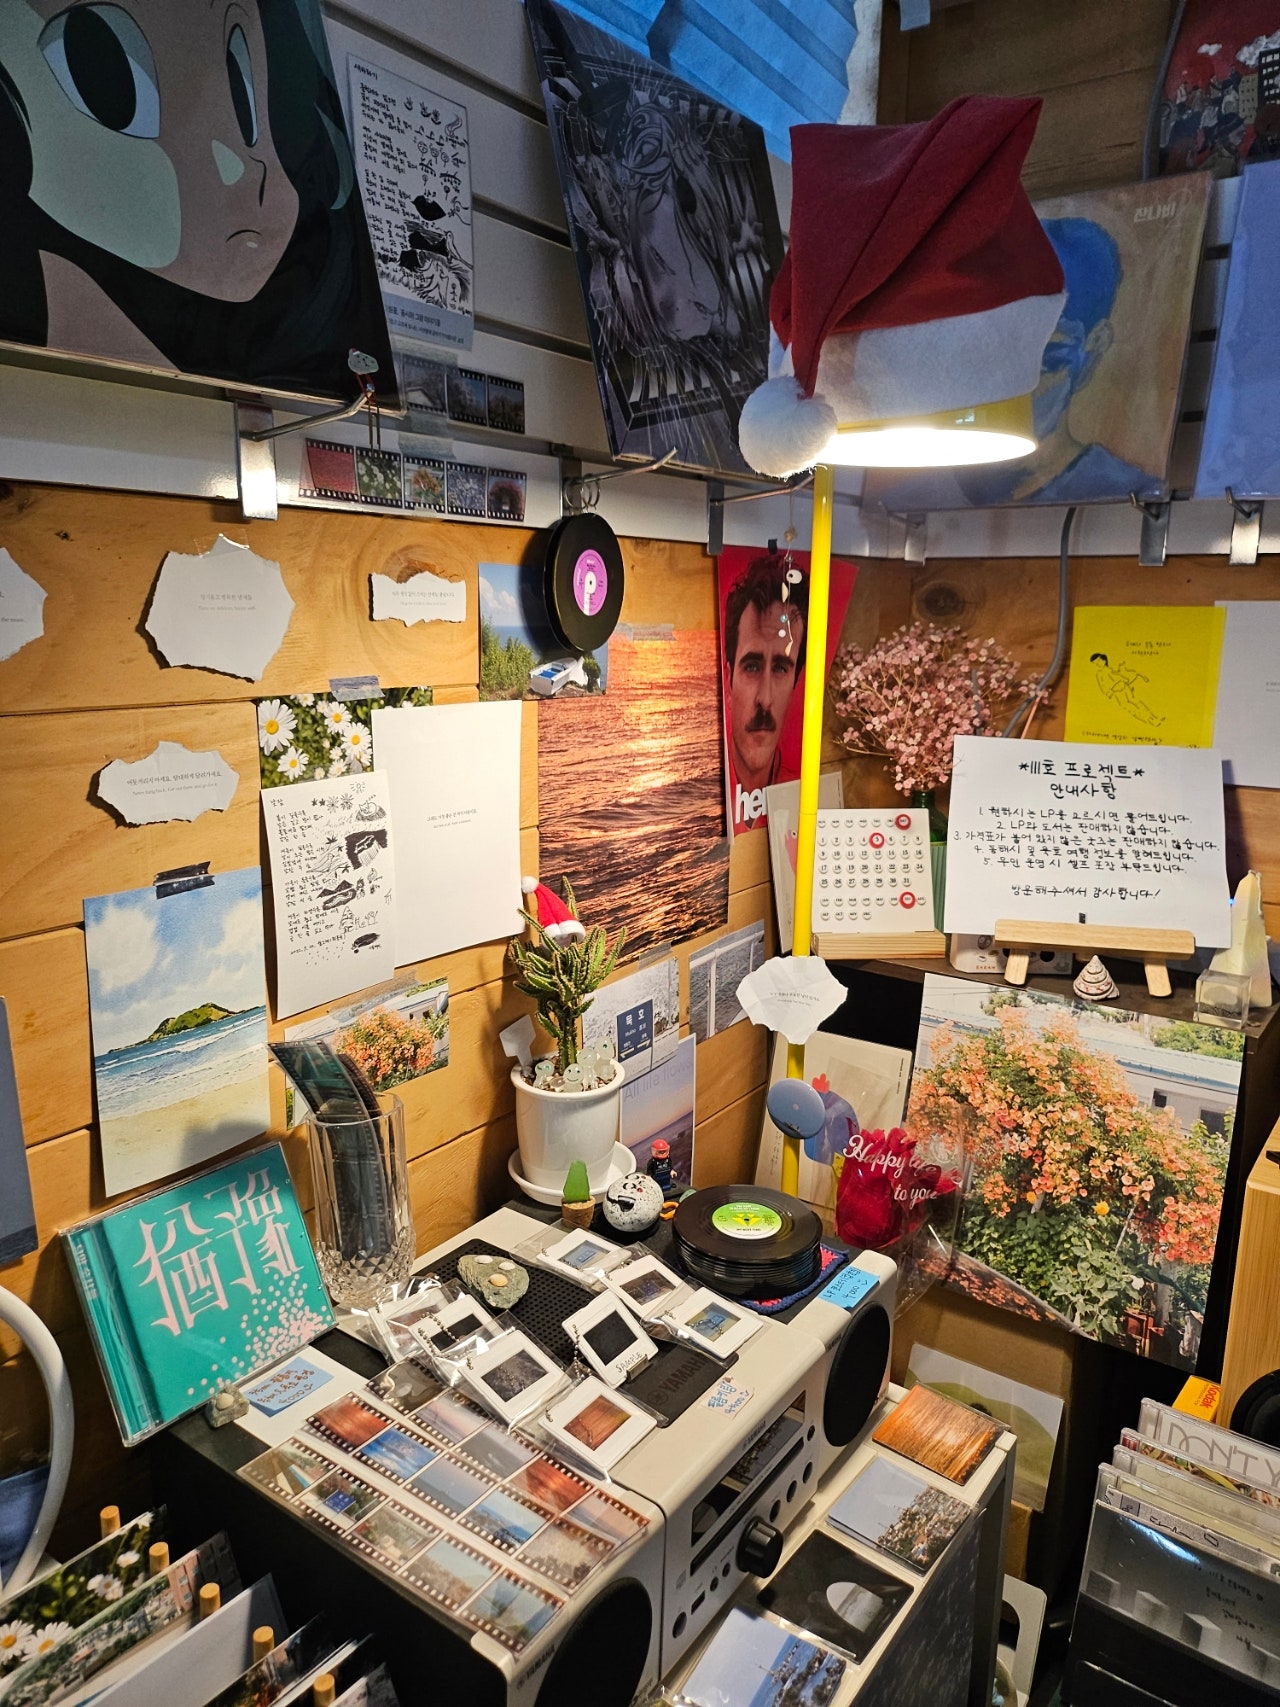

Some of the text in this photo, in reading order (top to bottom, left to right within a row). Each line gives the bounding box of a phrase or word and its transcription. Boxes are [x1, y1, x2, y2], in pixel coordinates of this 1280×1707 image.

[1050, 780, 1117, 800] 안내사항
[1041, 809, 1067, 819] LP를
[1072, 811, 1120, 822] 고르시면
[1011, 820, 1037, 831] LP와
[1042, 823, 1072, 833] 도서는
[1078, 823, 1121, 834] 판매하지
[1126, 825, 1173, 836] 않습니다.
[954, 831, 961, 840] 3.
[966, 831, 1006, 841] 가격표가
[1011, 833, 1031, 844] 붙어
[1036, 834, 1055, 844] 있지
[1060, 835, 1081, 846] 않은
[1122, 837, 1167, 848] 판매하지
[1171, 839, 1219, 851] 않습니다.
[989, 845, 1020, 854] 동해시
[1028, 846, 1035, 857] 및
[1067, 847, 1089, 859] 여행
[1132, 849, 1197, 862] 알려드립니다.
[984, 857, 1187, 874] 5. 무인 운영 시 셀프 포장 부탁드립니다.
[1012, 885, 1160, 900] 방문해주셔서 감사합니다!
[625, 1058, 692, 1102] All life flows
[843, 1135, 906, 1179] Happy
[894, 1184, 938, 1210] to you
[616, 1352, 643, 1373] SAMPLE
[659, 1356, 709, 1392] YAMAH
[1200, 1385, 1222, 1408] Kodak
[1168, 1422, 1258, 1476] DON'T
